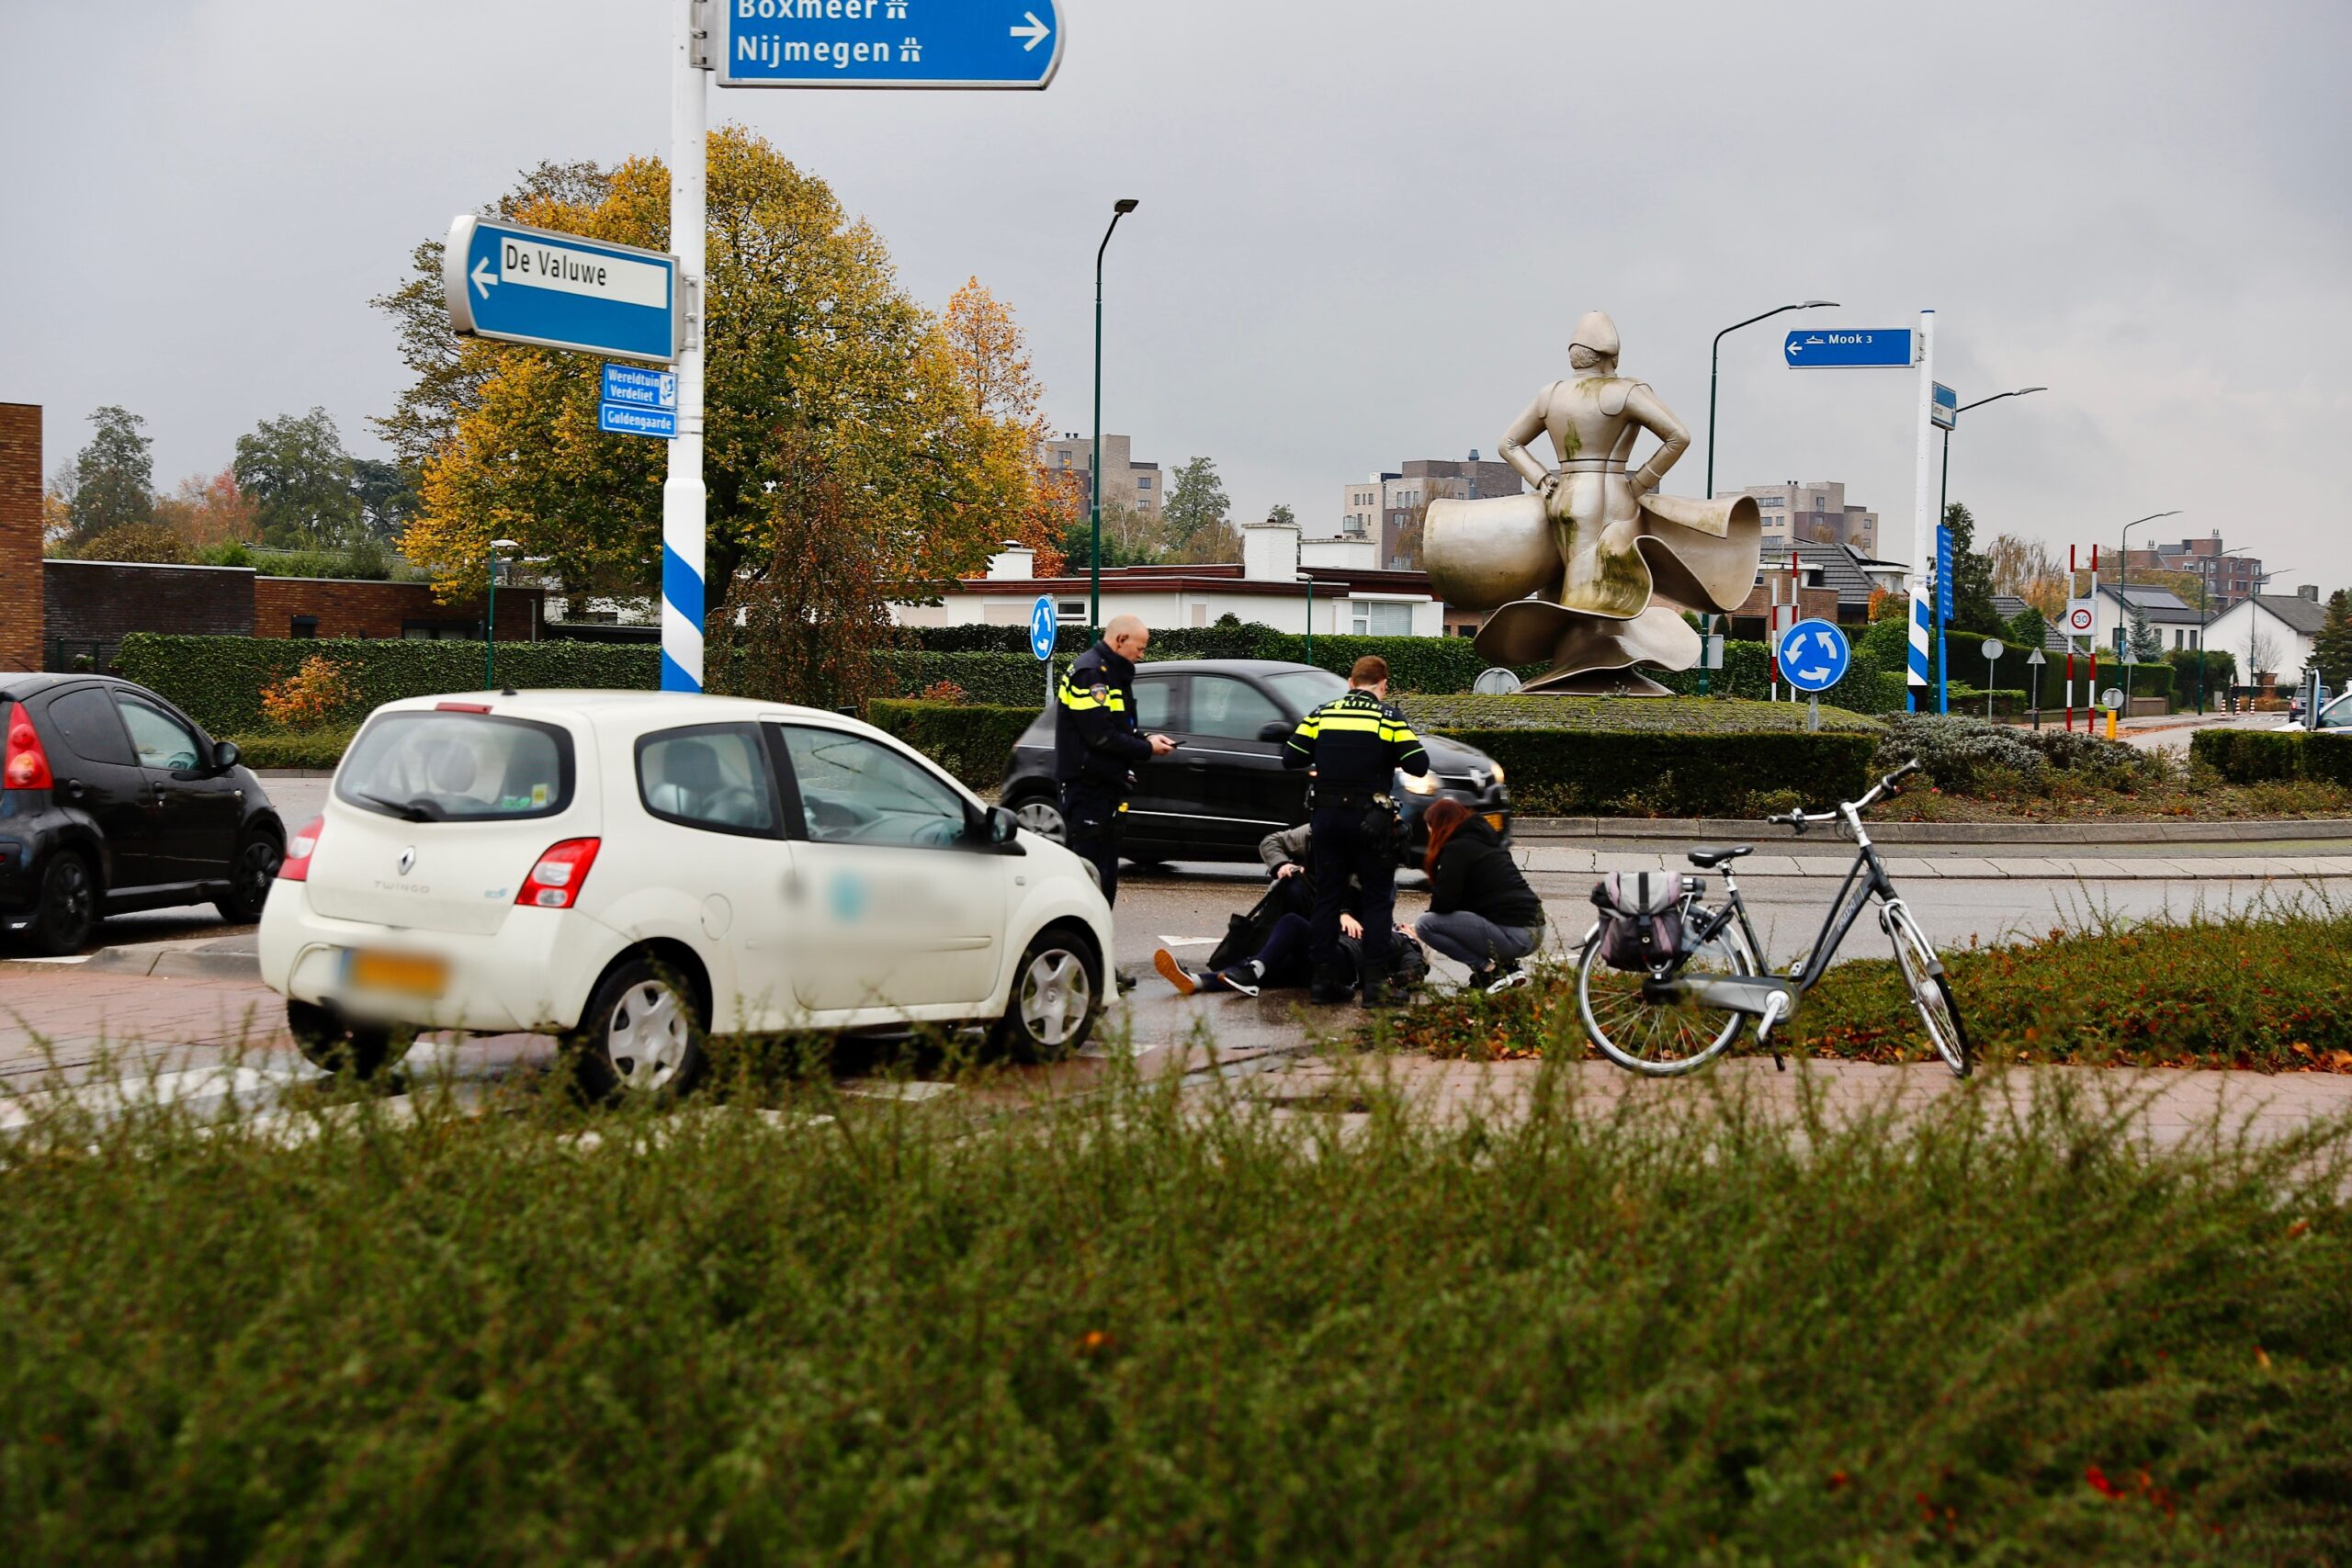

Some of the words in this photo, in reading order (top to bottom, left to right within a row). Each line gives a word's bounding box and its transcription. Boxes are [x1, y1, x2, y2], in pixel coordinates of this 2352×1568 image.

[738, 0, 877, 18] Boxmeer
[738, 35, 890, 69] Nijmegen
[506, 244, 530, 273] De
[538, 250, 606, 286] Valuwe
[1828, 334, 1862, 344] Mook
[1866, 335, 1872, 344] 3
[608, 368, 660, 388] Wereldtuin
[610, 385, 653, 401] Verdeliet
[607, 411, 672, 430] Guldengaarde
[2075, 615, 2087, 624] 30
[374, 880, 430, 894] TWINGO
